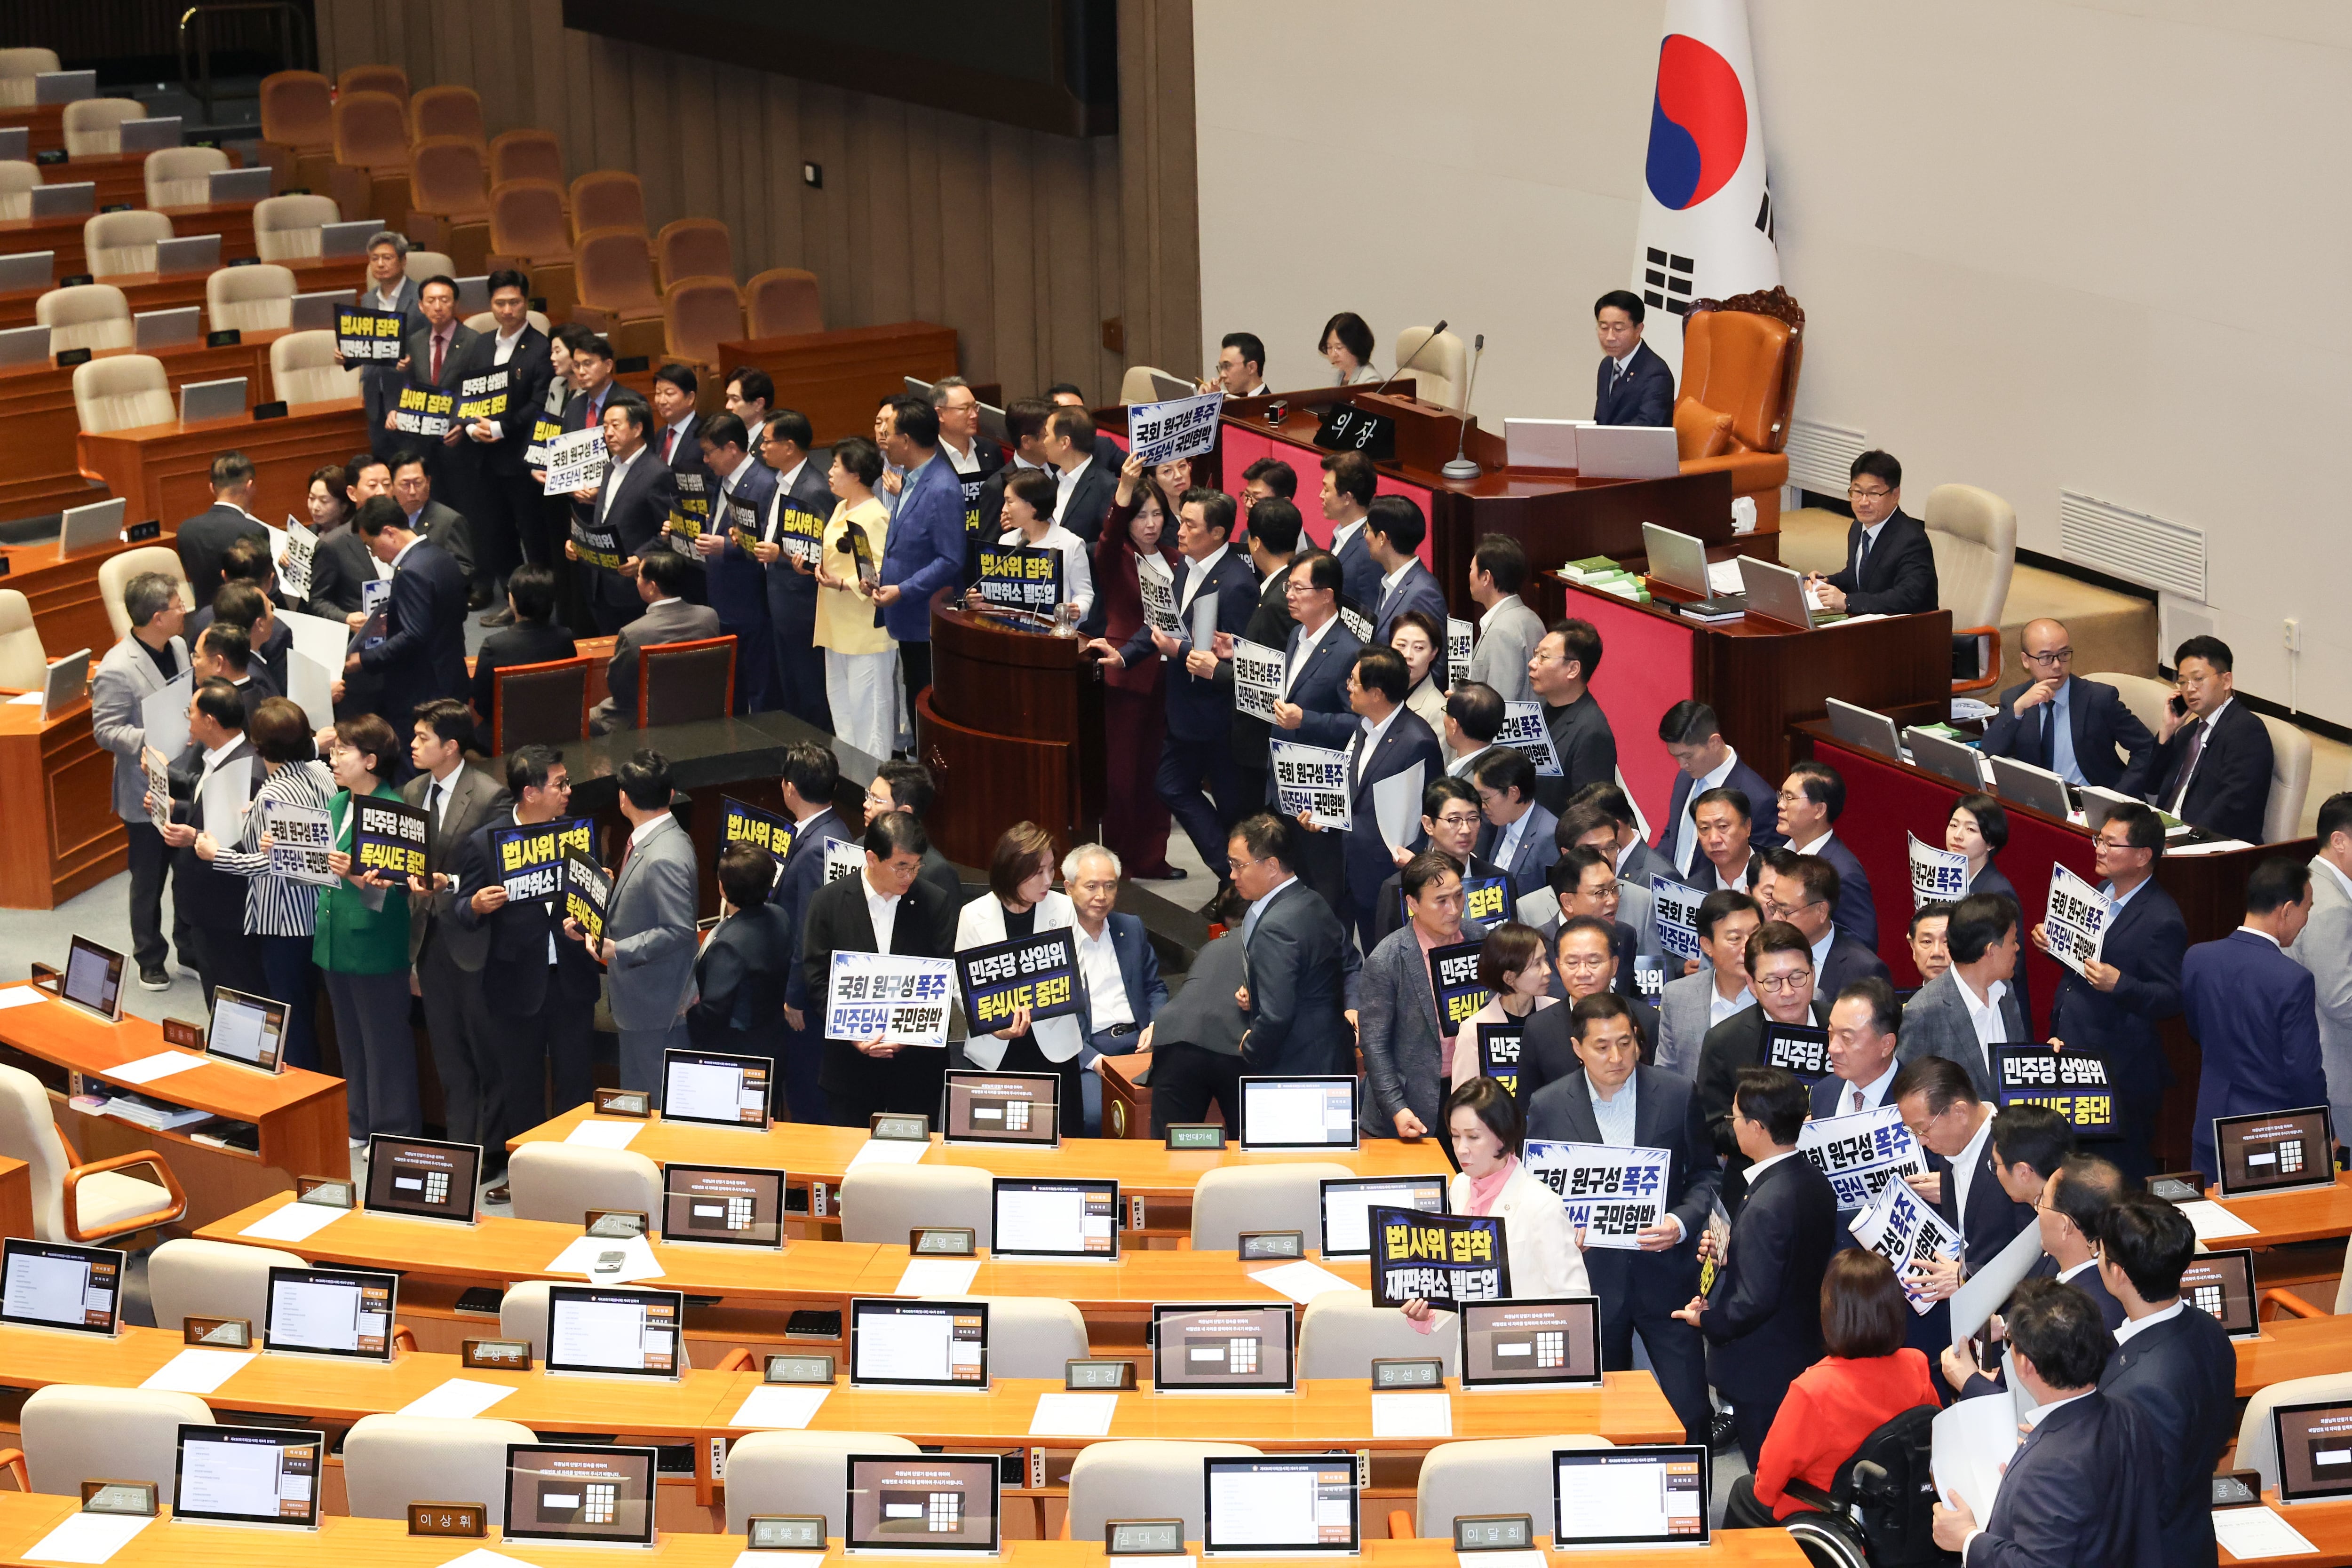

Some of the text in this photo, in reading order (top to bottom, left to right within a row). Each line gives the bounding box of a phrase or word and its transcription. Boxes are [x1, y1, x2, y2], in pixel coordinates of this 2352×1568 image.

[341, 315, 400, 337] 법사위 집착
[462, 371, 508, 396] 민주당 상임위
[399, 388, 453, 414] 법사위 집착
[1136, 402, 1218, 444] 국회 원구성 폭주
[1175, 425, 1213, 452] 국민협박
[553, 450, 568, 468] 국회
[570, 440, 591, 464] 원구성
[549, 467, 581, 491] 민주당식
[784, 508, 814, 536] 법사위
[980, 554, 1054, 579] 법사위 집착
[980, 581, 1056, 605] 재판취소 빌드업
[1459, 635, 1471, 659] 폭주
[1237, 657, 1282, 686] 국회 원구성 폭주
[1238, 685, 1260, 710] 민주당식
[1520, 714, 1541, 738] 폭주
[1277, 761, 1343, 788] 국회 원구성 폭주
[1313, 792, 1345, 818] 국민협박
[270, 820, 329, 846] 국회 원구성 폭주
[362, 807, 426, 845] 민주당 상임위
[727, 814, 794, 858] 법사위 집착
[273, 848, 331, 874] 민주당식 국민협
[359, 842, 427, 877] 독식시도 중단!
[501, 832, 556, 872] 법사위
[503, 868, 556, 903] 재판취소
[568, 857, 608, 911] 민주당 상임위
[1915, 861, 1963, 893] 원구성 폭주
[565, 891, 592, 931] 독식시도
[1467, 884, 1504, 919] 집착
[1657, 896, 1683, 923] 국회
[2051, 889, 2104, 936] 국회 원구성 폭주
[968, 941, 1067, 986] 민주당 상임위
[837, 974, 947, 1001] 국회 원구성 폭주
[977, 975, 1071, 1023] 독식시도 중단!
[832, 1007, 943, 1034] 민주당식 국민협박
[1489, 1037, 1520, 1062] 민주
[1771, 1037, 1824, 1071] 민주당
[2002, 1056, 2107, 1085] 민주당 상임위
[603, 1098, 639, 1110] 김재섭
[2074, 1095, 2111, 1125] 중단!
[879, 1123, 920, 1134] 조지연
[1178, 1133, 1212, 1141] 발언대기석
[1827, 1132, 1875, 1170] 원구성
[1874, 1121, 1911, 1159] 폭주
[305, 1186, 344, 1199] 진종오
[1571, 1167, 1622, 1195] 원구성
[1622, 1166, 1661, 1196] 폭주
[2156, 1182, 2195, 1197] 김소희
[595, 1219, 637, 1231] 한지아
[1593, 1204, 1656, 1235] 국민협박
[1889, 1192, 1917, 1239] 폭주
[921, 1237, 964, 1249] 강명구
[1249, 1240, 1293, 1253] 주진우
[1385, 1225, 1493, 1262] 법사위 집착
[1385, 1267, 1499, 1301] 재판취소 빌드업
[194, 1325, 238, 1341] 박정훈
[473, 1348, 519, 1362] 안상훈
[775, 1363, 822, 1377] 박수민
[1086, 1370, 1116, 1383] 김건
[1383, 1369, 1431, 1382] 강선영
[94, 1491, 142, 1507] 유용원
[1921, 1483, 1931, 1492] JAY
[421, 1513, 471, 1528] 이상휘
[760, 1527, 812, 1541] 柳榮夏
[1118, 1531, 1171, 1545] 김대식
[1467, 1526, 1519, 1542] 이달희
